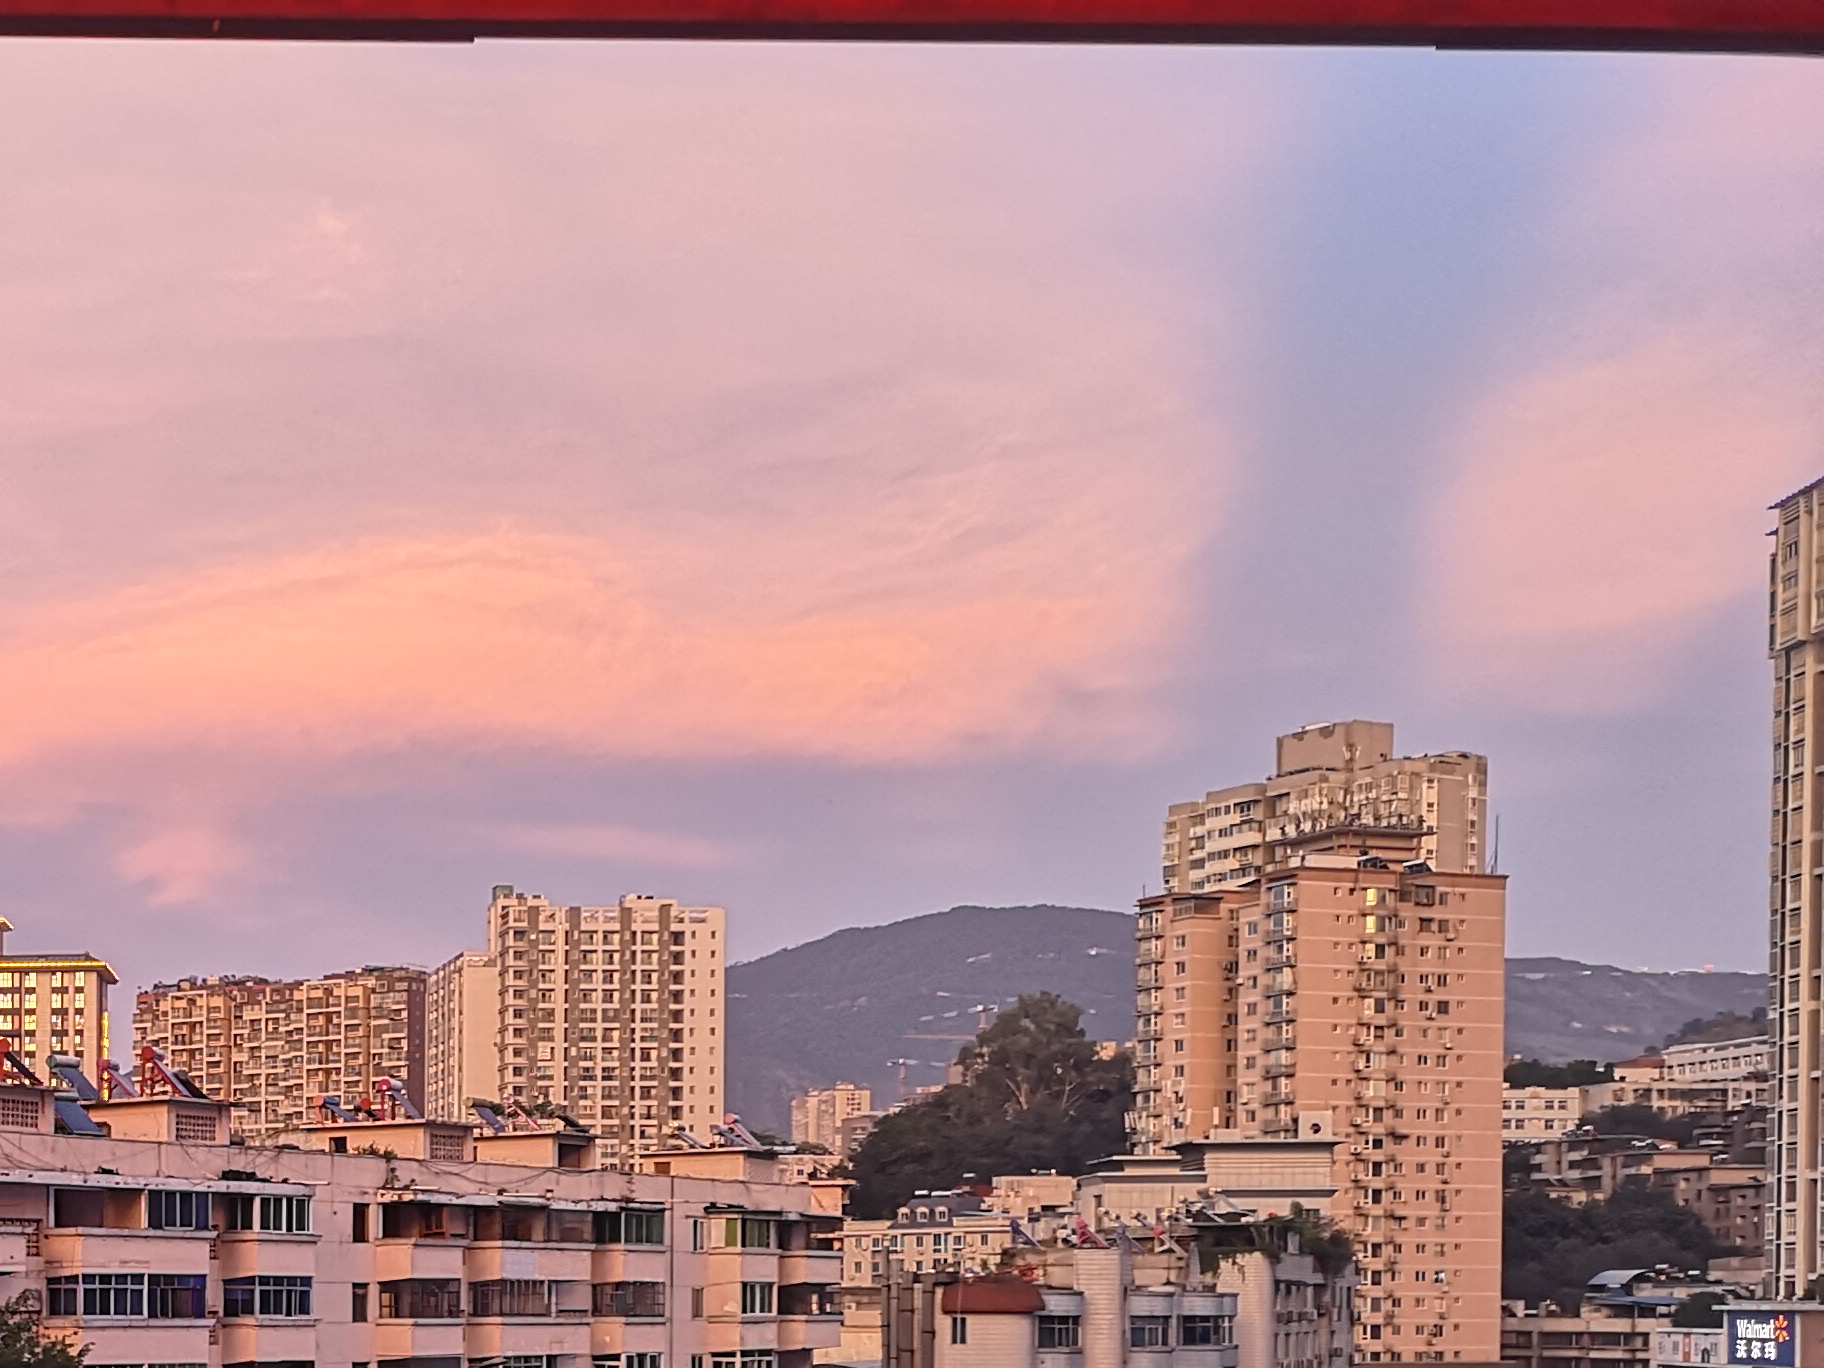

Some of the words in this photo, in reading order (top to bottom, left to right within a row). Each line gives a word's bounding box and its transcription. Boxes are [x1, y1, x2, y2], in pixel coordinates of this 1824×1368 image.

[1736, 1319, 1775, 1339] Walmart
[1736, 1340, 1776, 1360] 沃尔玛
